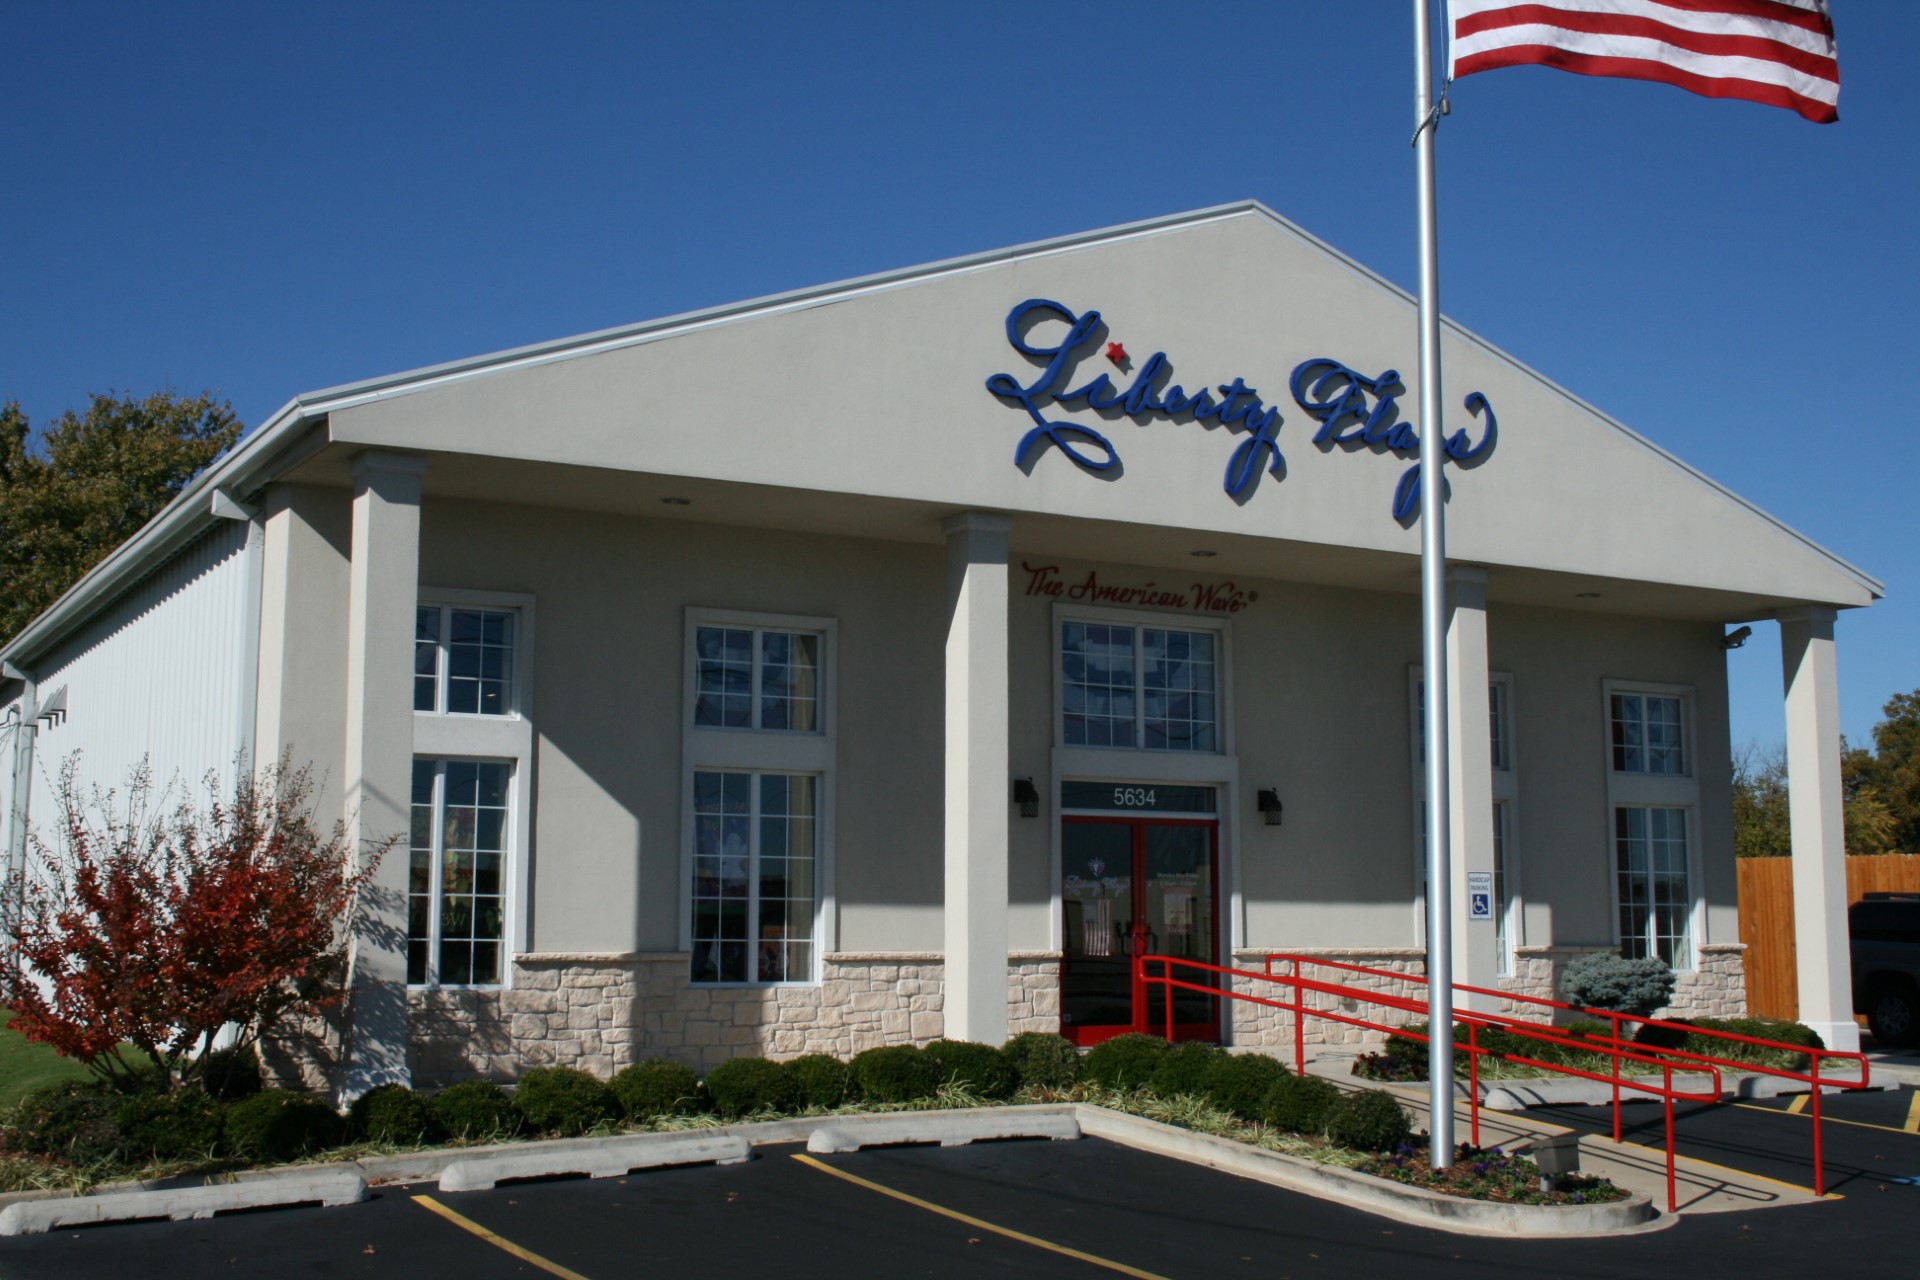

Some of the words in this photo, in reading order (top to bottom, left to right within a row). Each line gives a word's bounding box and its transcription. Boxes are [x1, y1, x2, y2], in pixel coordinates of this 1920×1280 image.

[985, 298, 1281, 496] Liberty
[1022, 561, 1063, 597] The
[1068, 571, 1189, 609] American
[1114, 788, 1156, 806] 5634
